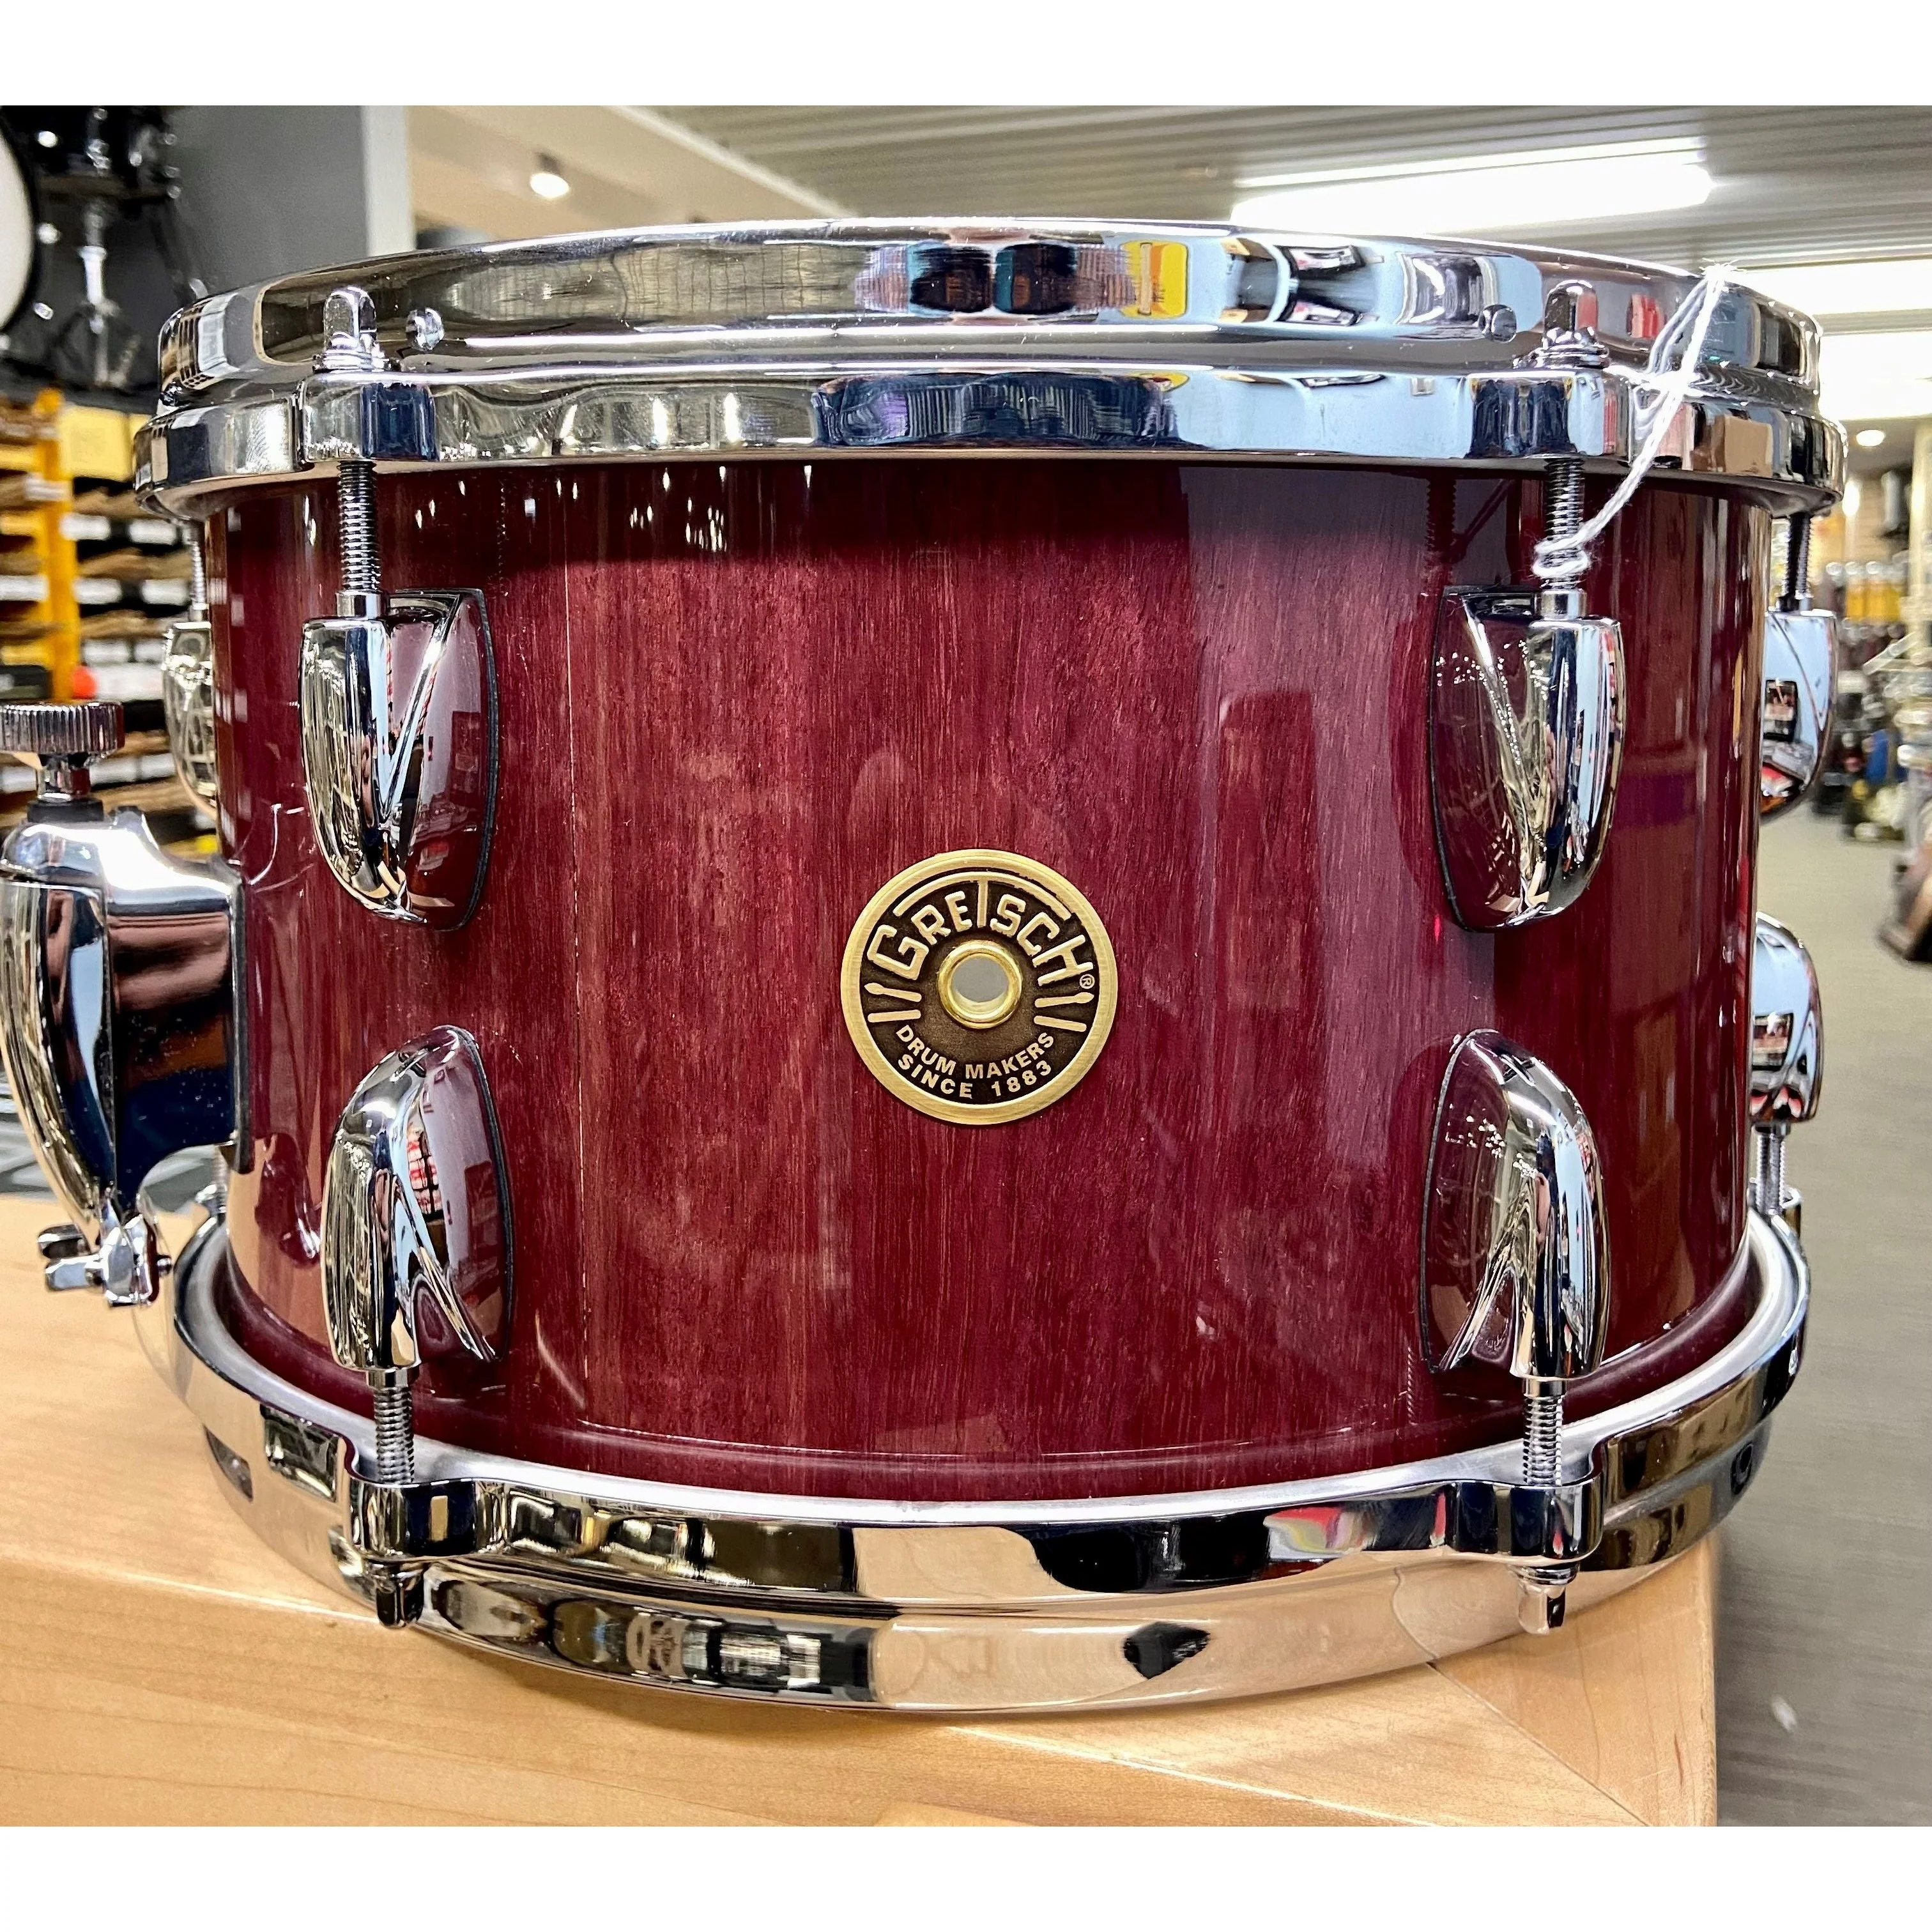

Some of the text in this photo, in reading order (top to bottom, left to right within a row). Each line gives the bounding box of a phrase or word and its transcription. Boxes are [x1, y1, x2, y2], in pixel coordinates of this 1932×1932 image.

[896, 1024, 1054, 1080] DRUM MAKERS
[898, 1054, 1052, 1099] SINCE 1883
